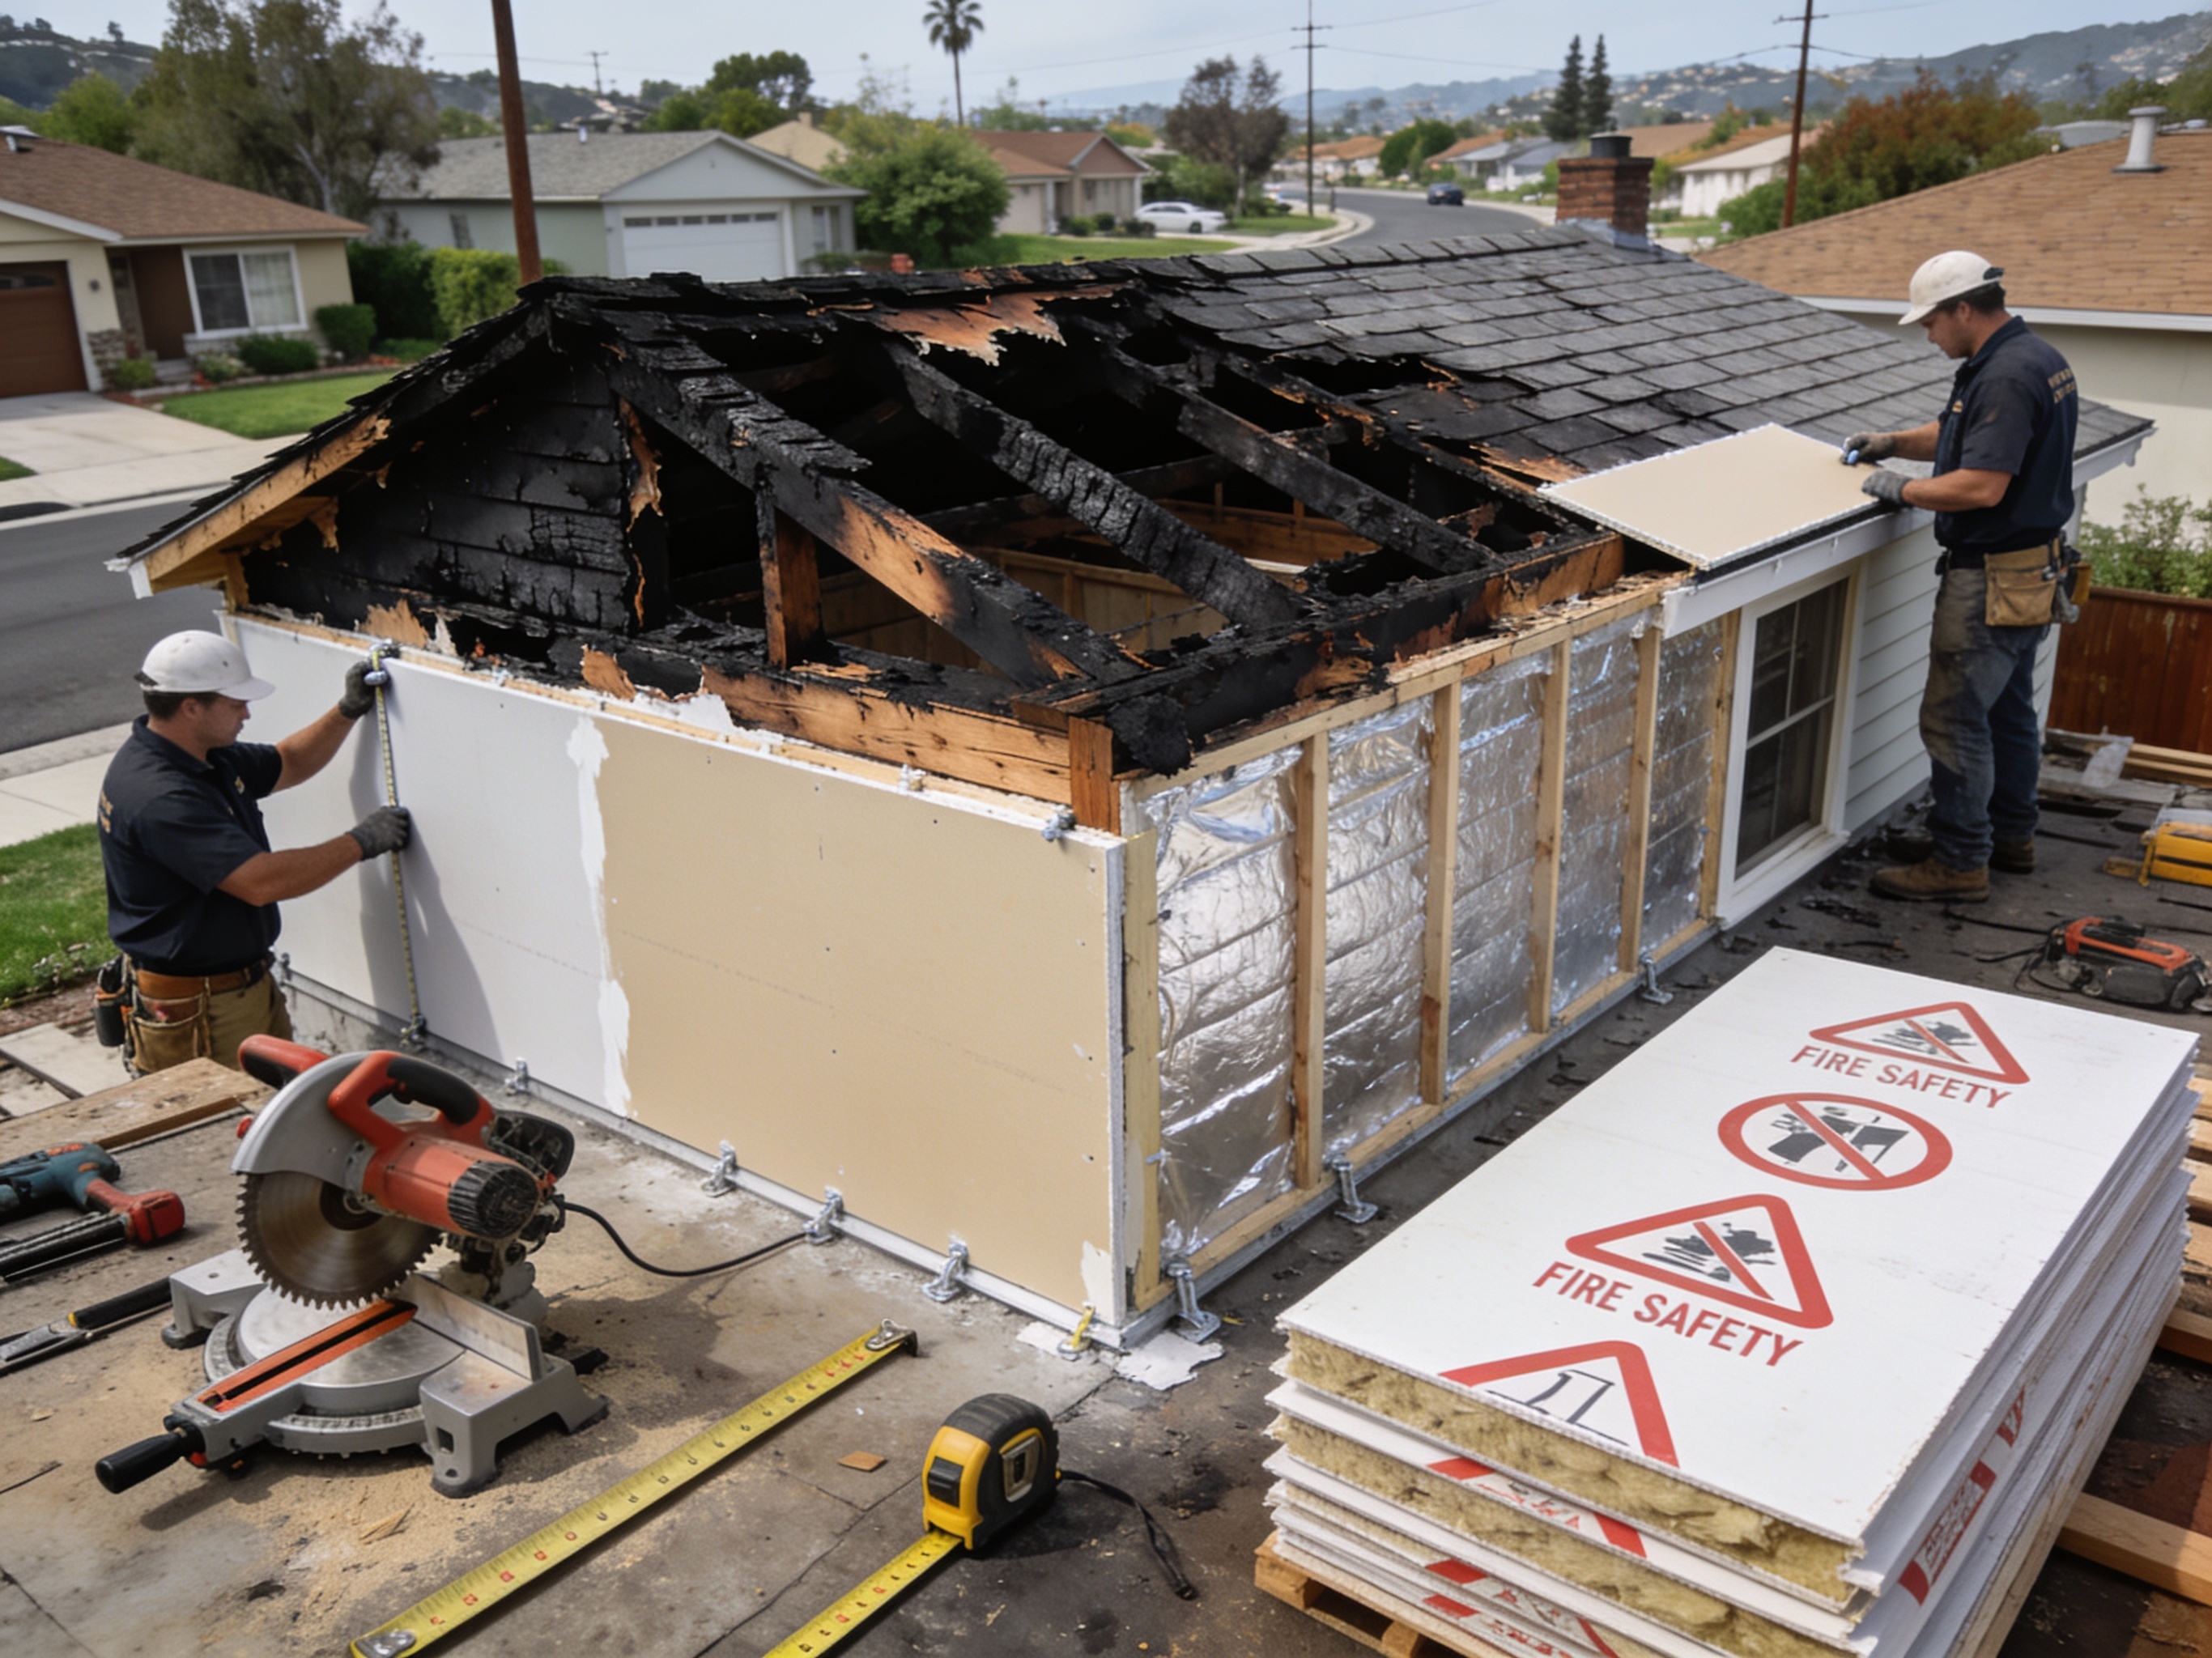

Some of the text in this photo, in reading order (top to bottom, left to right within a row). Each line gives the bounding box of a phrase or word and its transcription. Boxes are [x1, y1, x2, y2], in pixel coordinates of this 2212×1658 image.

[1790, 1044, 2013, 1109] FIRE SAFETY
[1532, 1261, 1804, 1367] FIRE SAFETY
